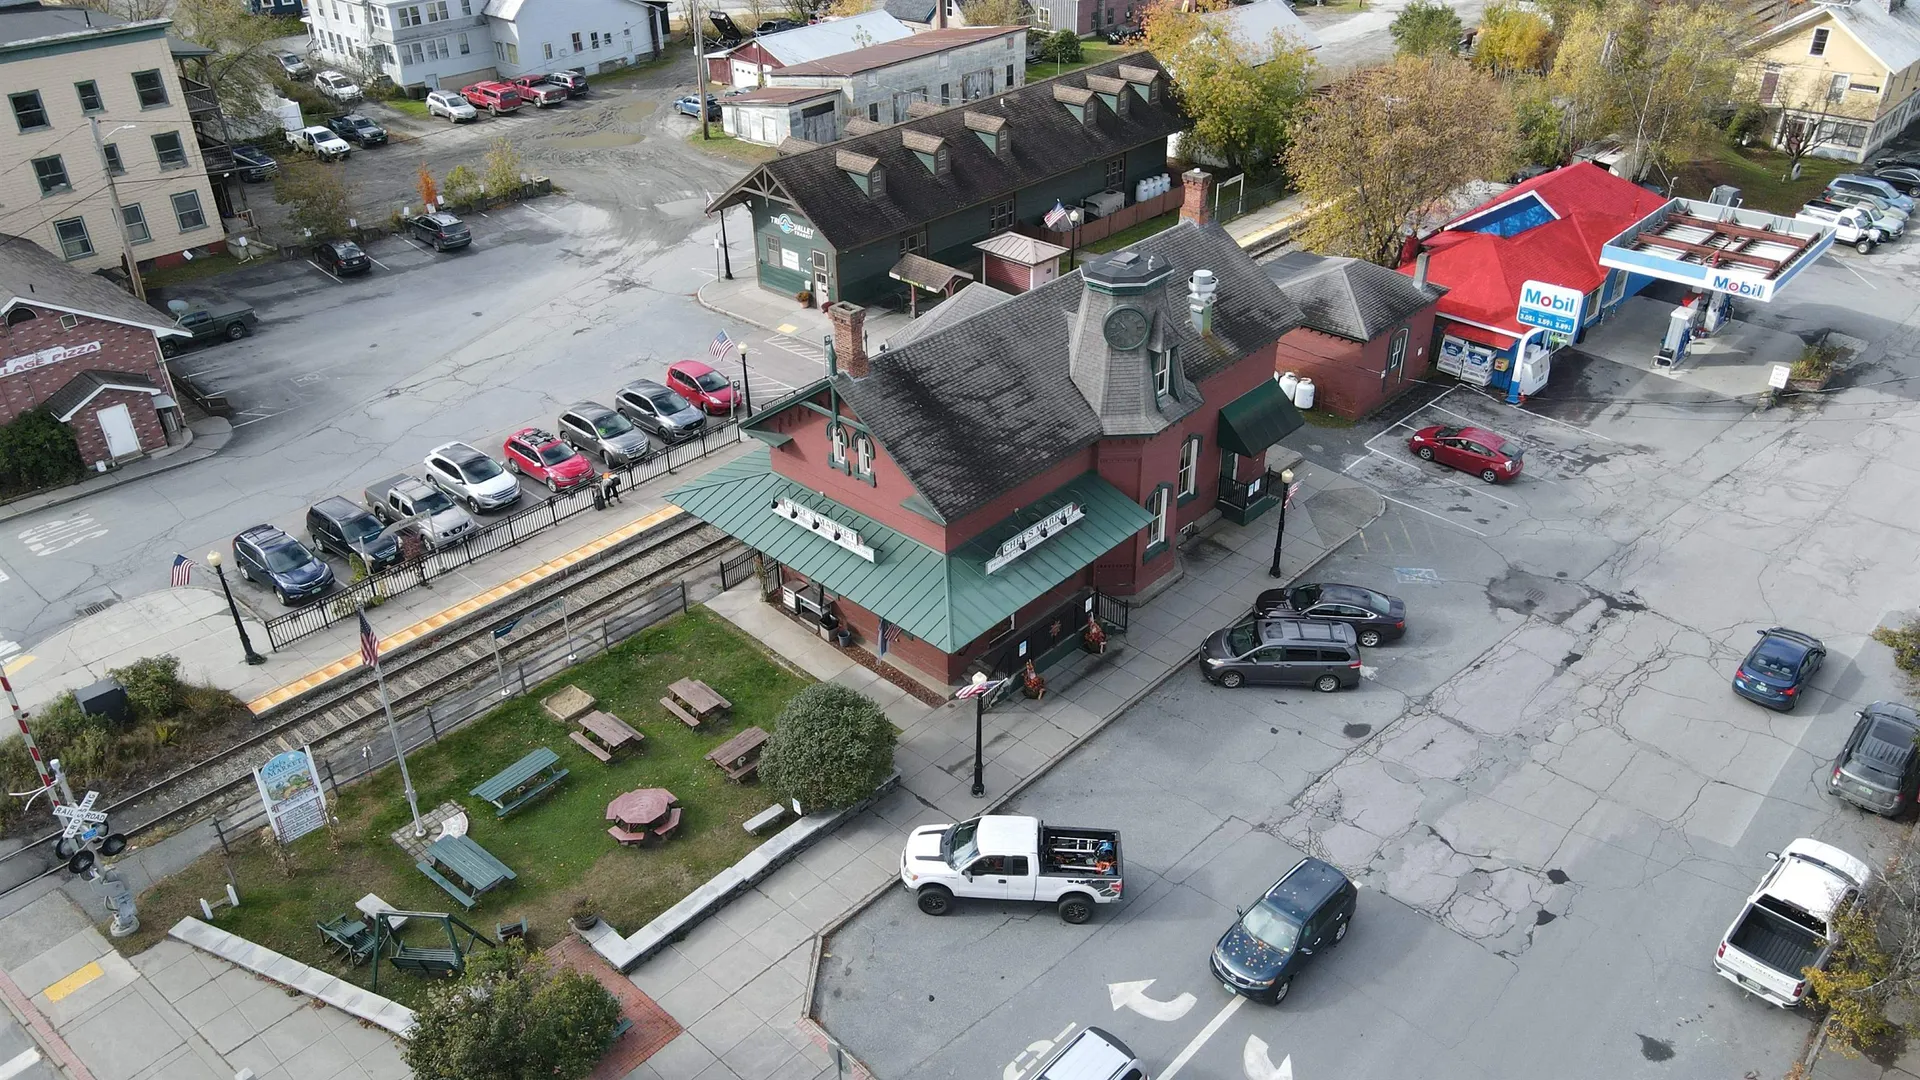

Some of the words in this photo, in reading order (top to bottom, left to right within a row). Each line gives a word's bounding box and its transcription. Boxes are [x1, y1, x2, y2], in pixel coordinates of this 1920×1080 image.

[793, 223, 815, 236] VALLEY
[1713, 275, 1763, 297] Mobil
[1524, 288, 1575, 313] Mobil
[52, 344, 97, 362] PIZZA
[818, 516, 856, 541] MARKET
[1036, 507, 1072, 533] MARKET
[18, 513, 109, 557] STOP
[267, 758, 305, 779] MARKET
[55, 807, 74, 817] RAIL
[85, 812, 106, 822] ROAD
[66, 793, 96, 836] CROSSING
